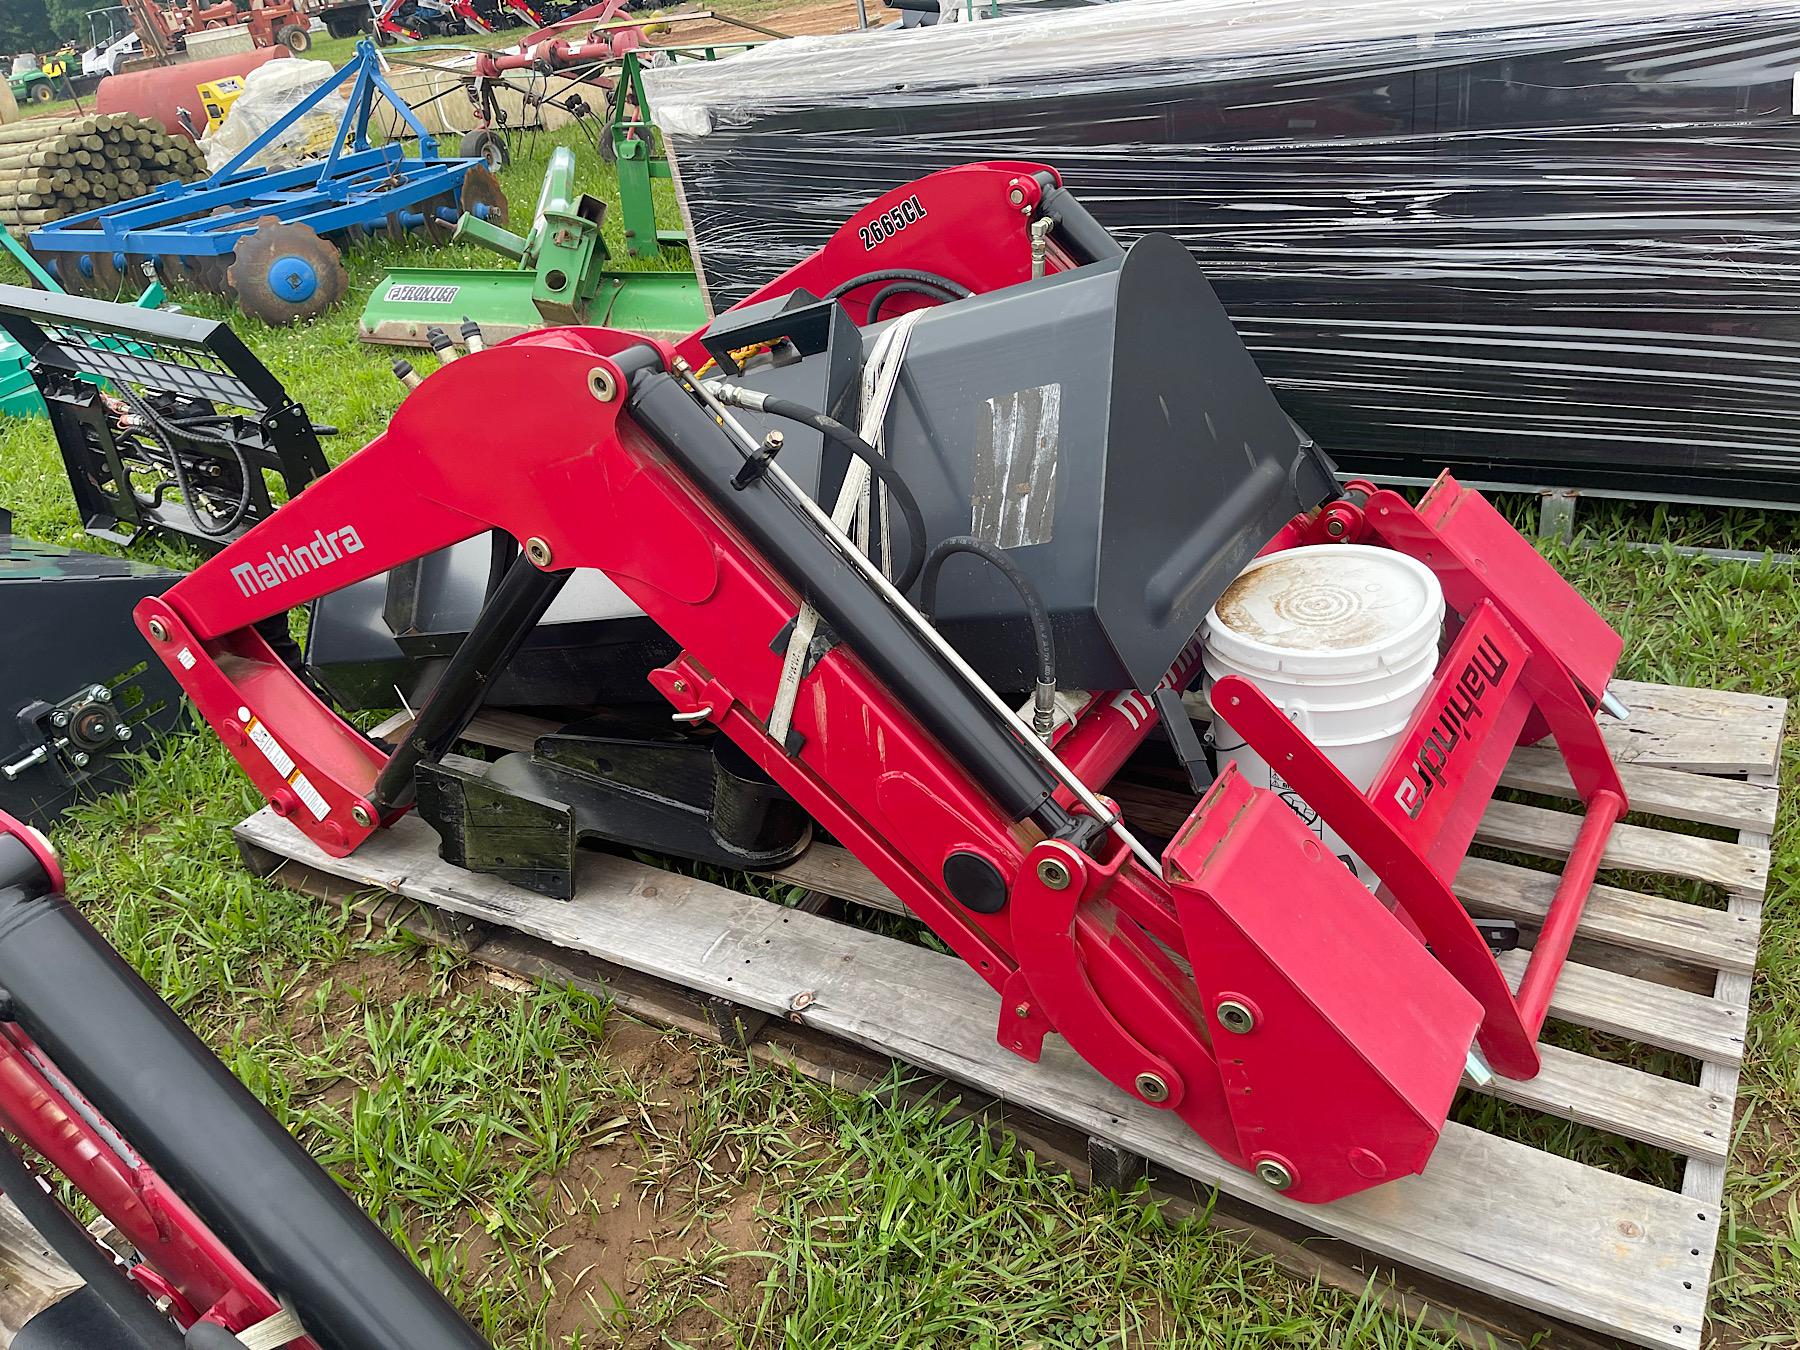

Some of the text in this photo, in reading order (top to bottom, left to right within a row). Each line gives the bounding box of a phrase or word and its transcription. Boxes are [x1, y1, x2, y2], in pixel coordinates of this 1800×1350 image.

[859, 194, 928, 251] 2665CL
[400, 286, 459, 302] FRONTIER
[230, 525, 364, 598] Mahindra
[1394, 635, 1508, 820] Mahindra
